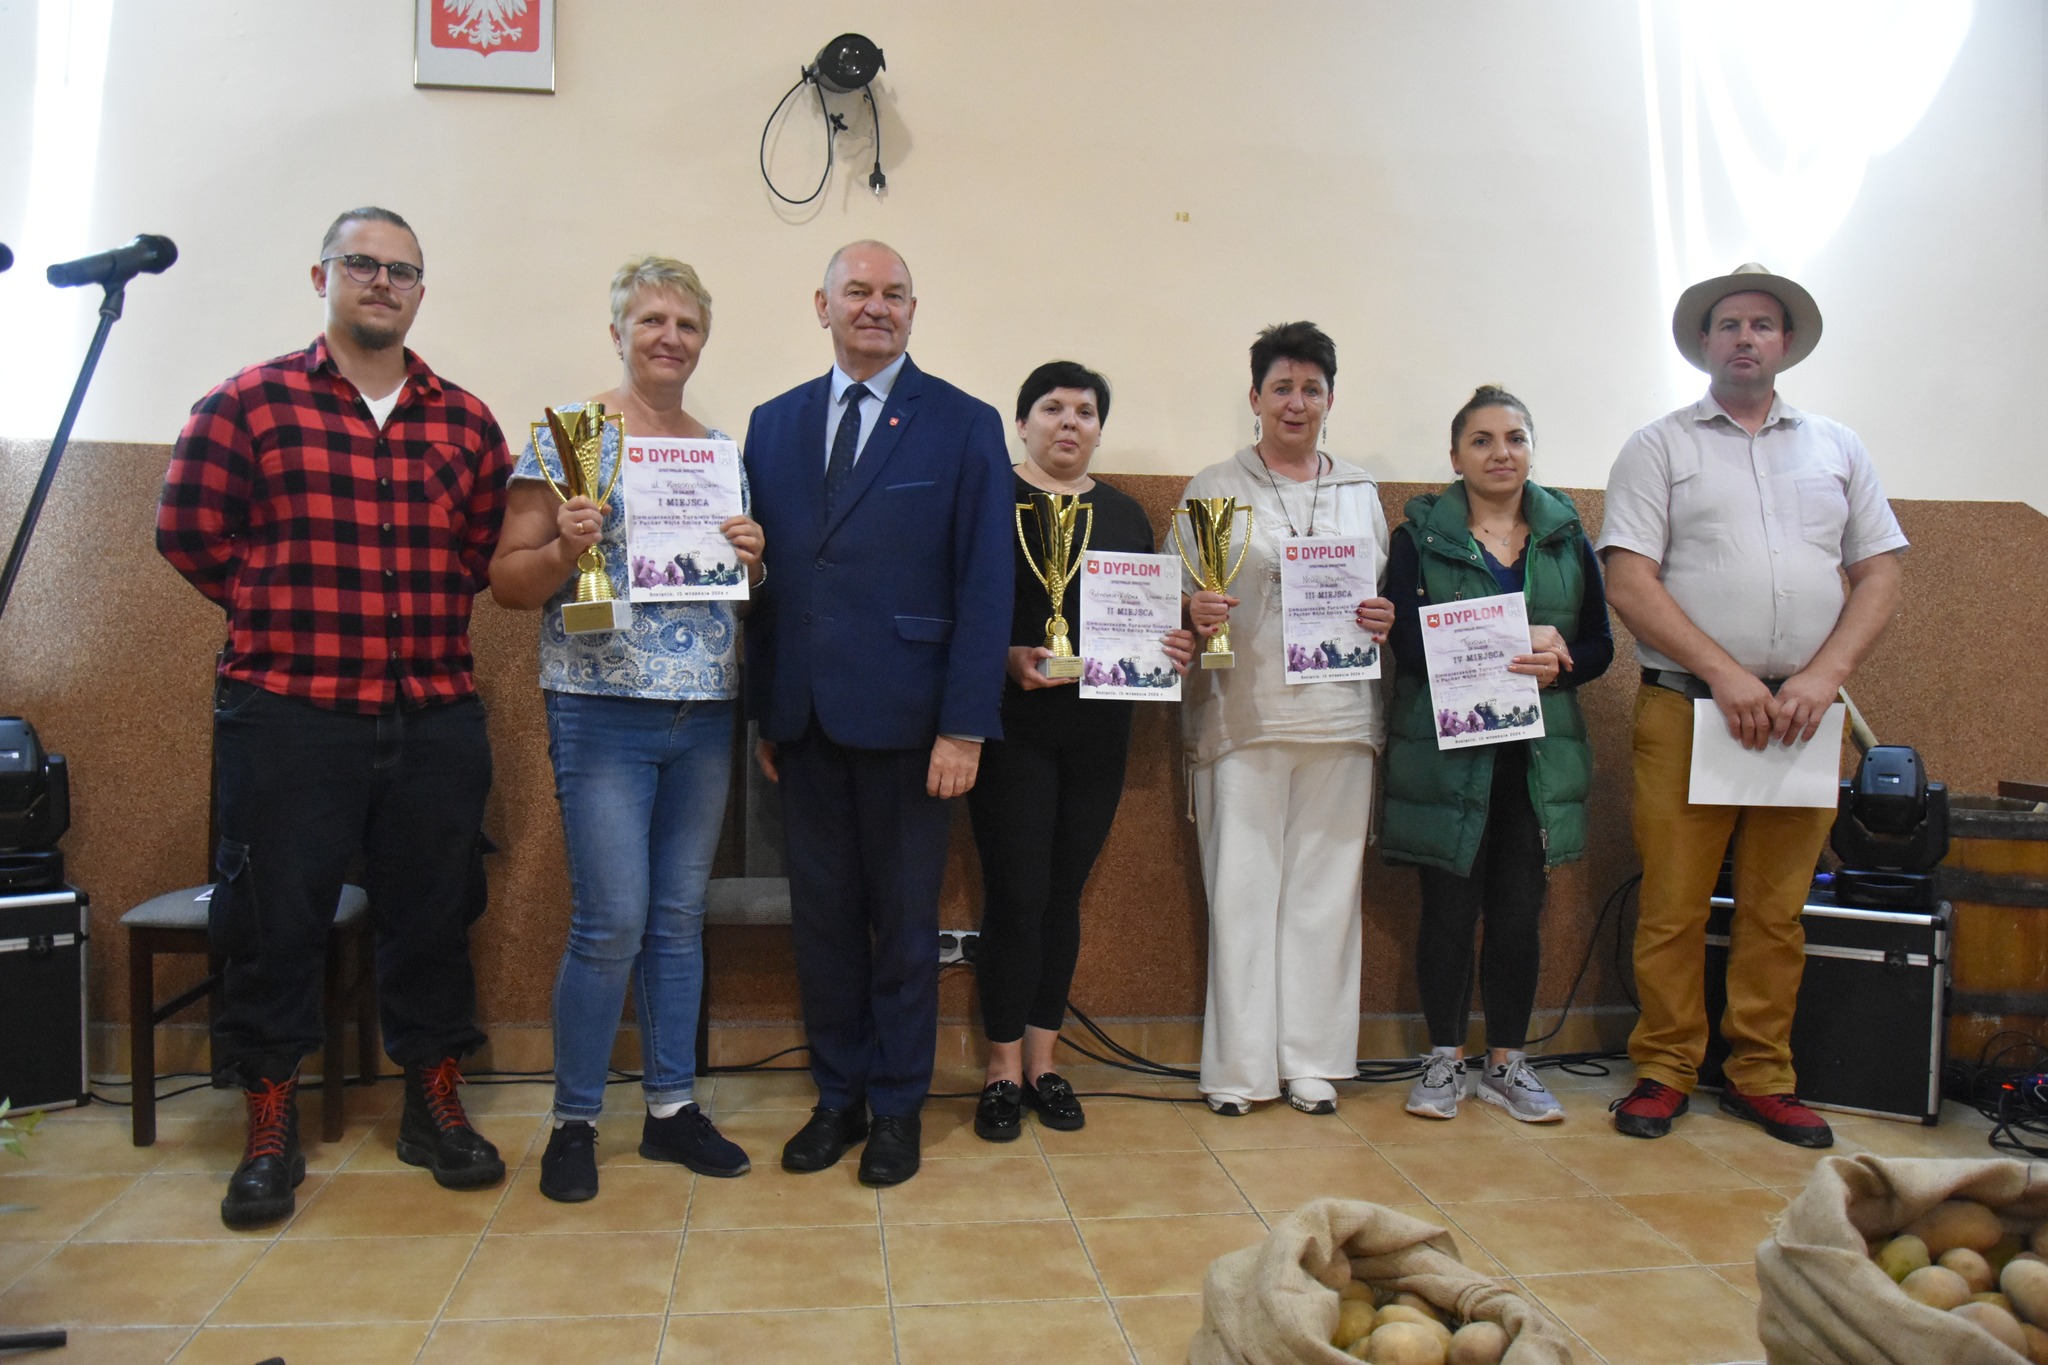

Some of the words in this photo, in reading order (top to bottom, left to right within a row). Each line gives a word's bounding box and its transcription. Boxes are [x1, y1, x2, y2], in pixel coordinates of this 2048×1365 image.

[648, 448, 714, 463] DYPLOM
[1302, 546, 1355, 560] DYPLOM
[1104, 562, 1160, 576] DYPLOM
[1318, 590, 1352, 598] MIEJSCA
[1118, 608, 1154, 616] MIEJSCA
[1444, 605, 1504, 625] DYPLOM
[1466, 651, 1504, 662] MIEJSCA
